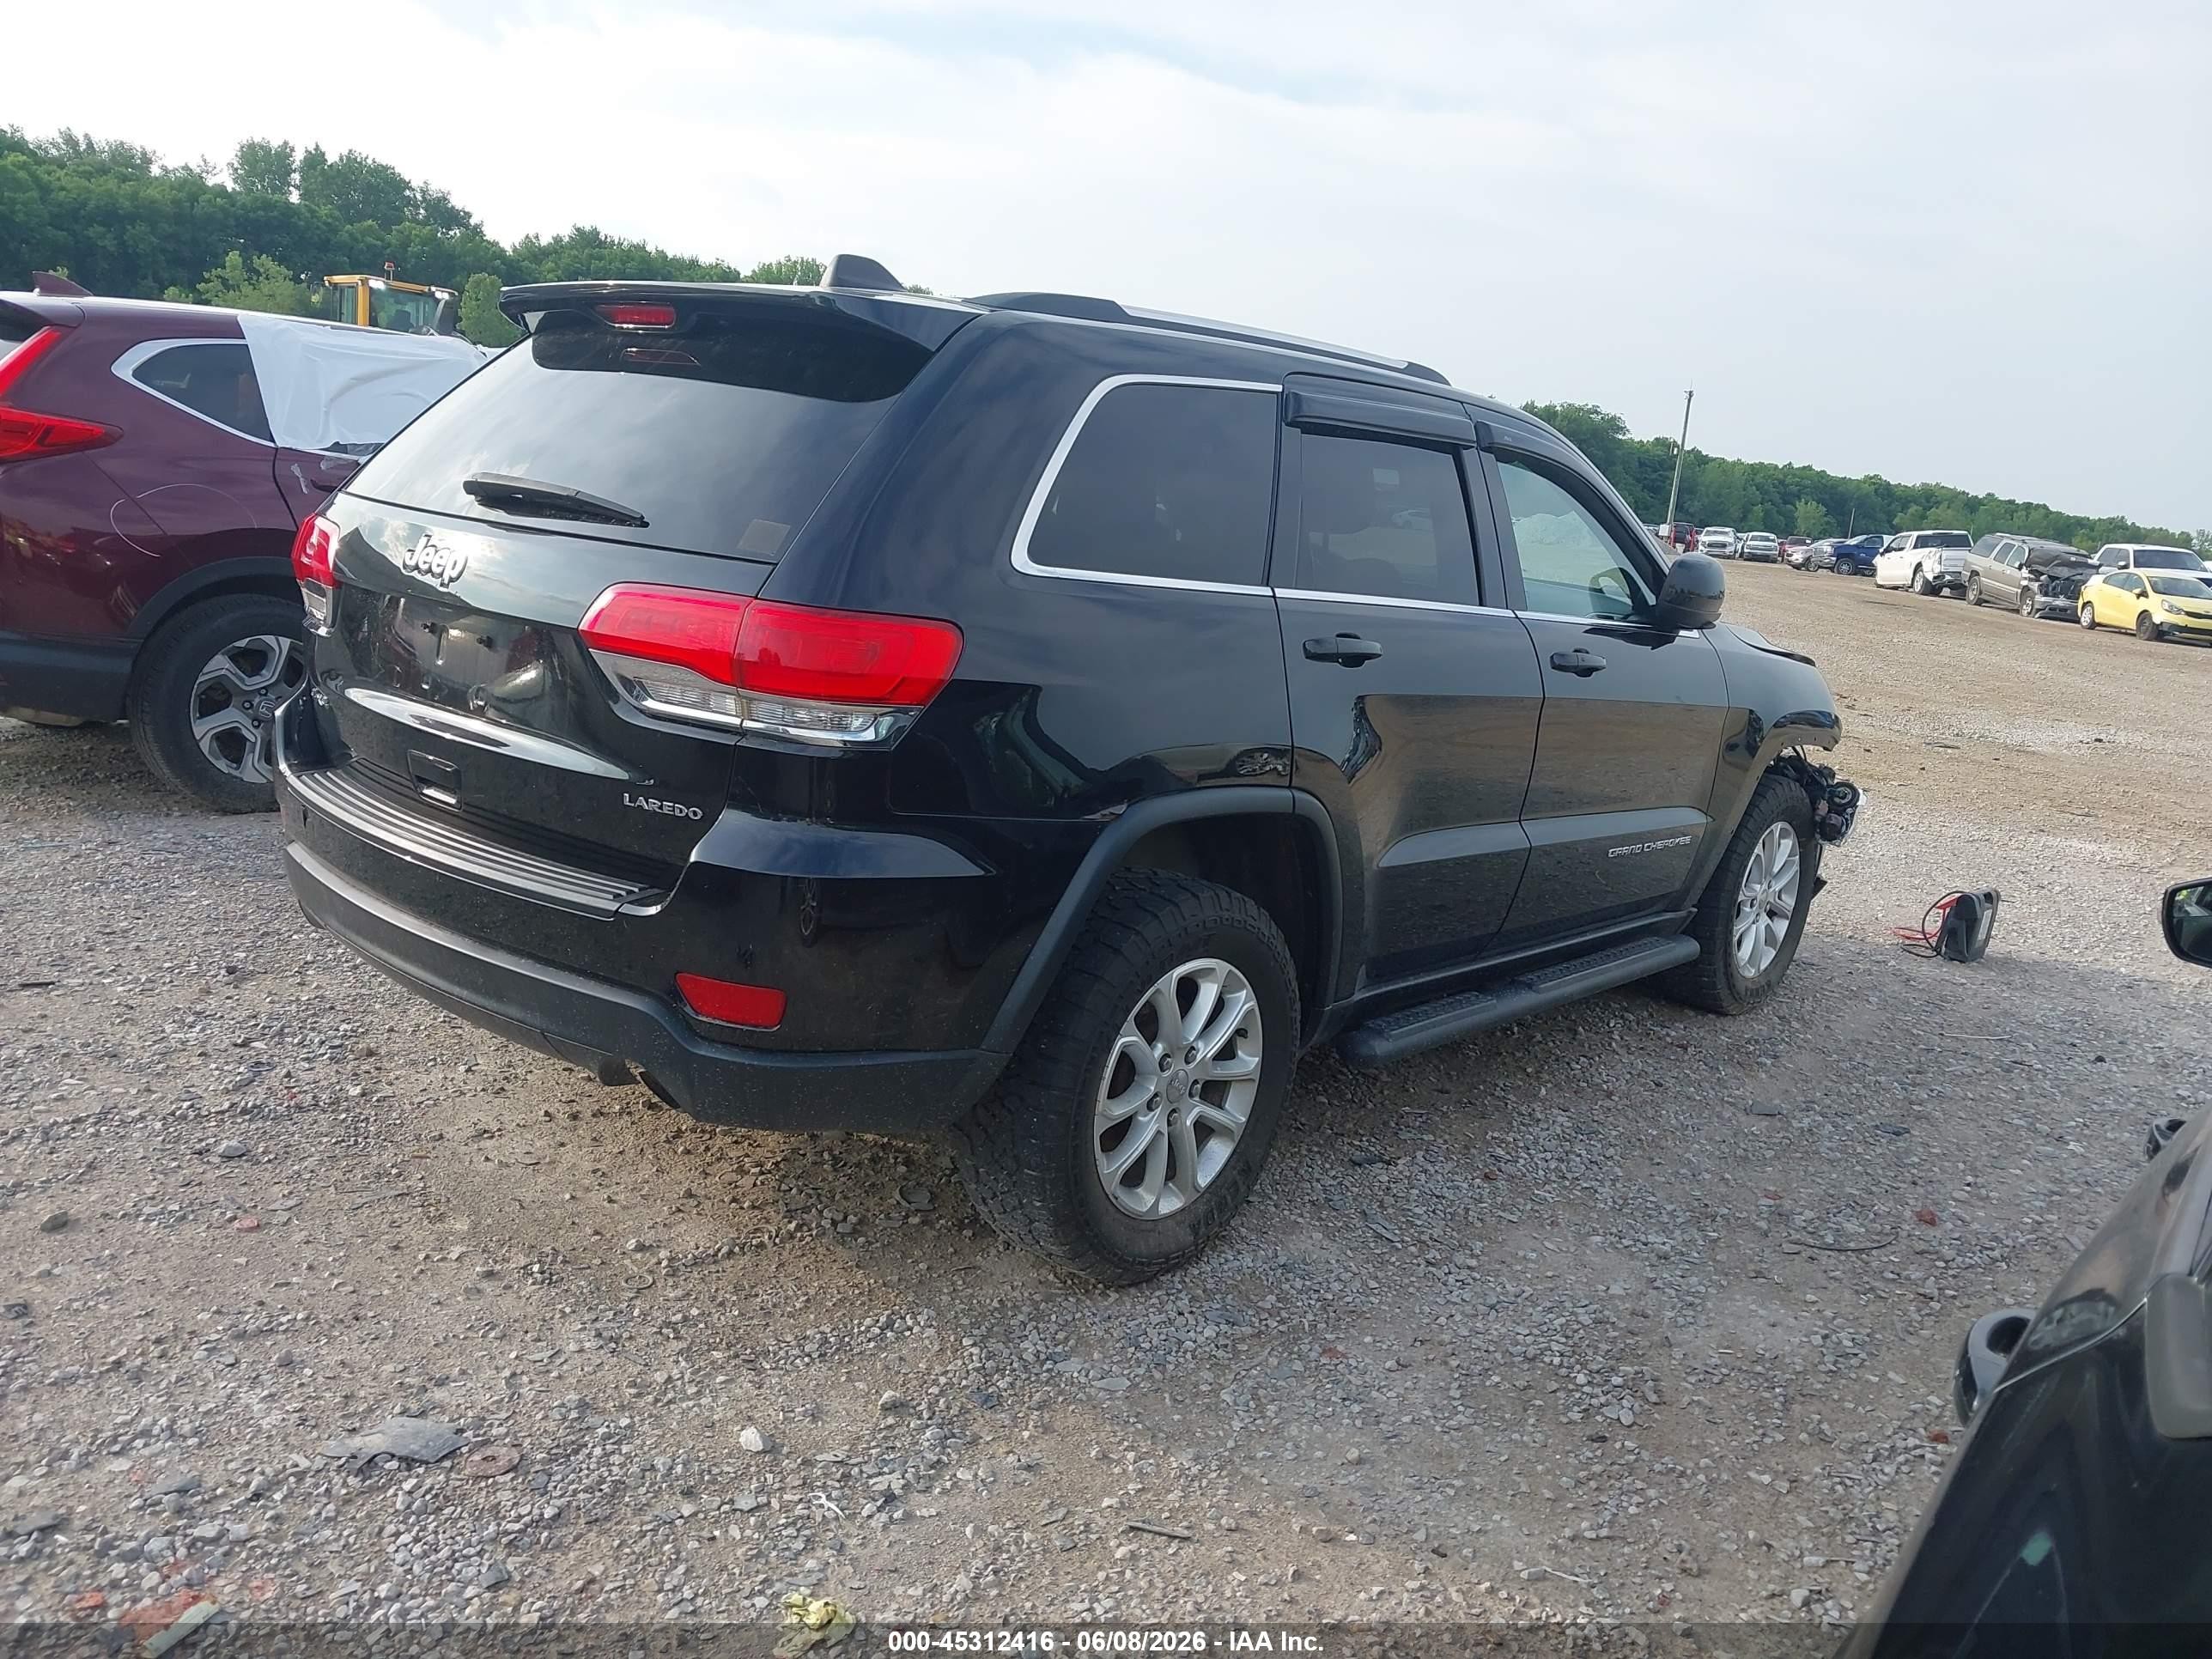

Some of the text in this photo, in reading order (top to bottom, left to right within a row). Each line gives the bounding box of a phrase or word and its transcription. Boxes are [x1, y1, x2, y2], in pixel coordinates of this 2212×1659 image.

[403, 532, 468, 589] Jeep
[623, 793, 703, 820] LAREDO
[1608, 836, 1692, 857] GRAND CHEROKEE
